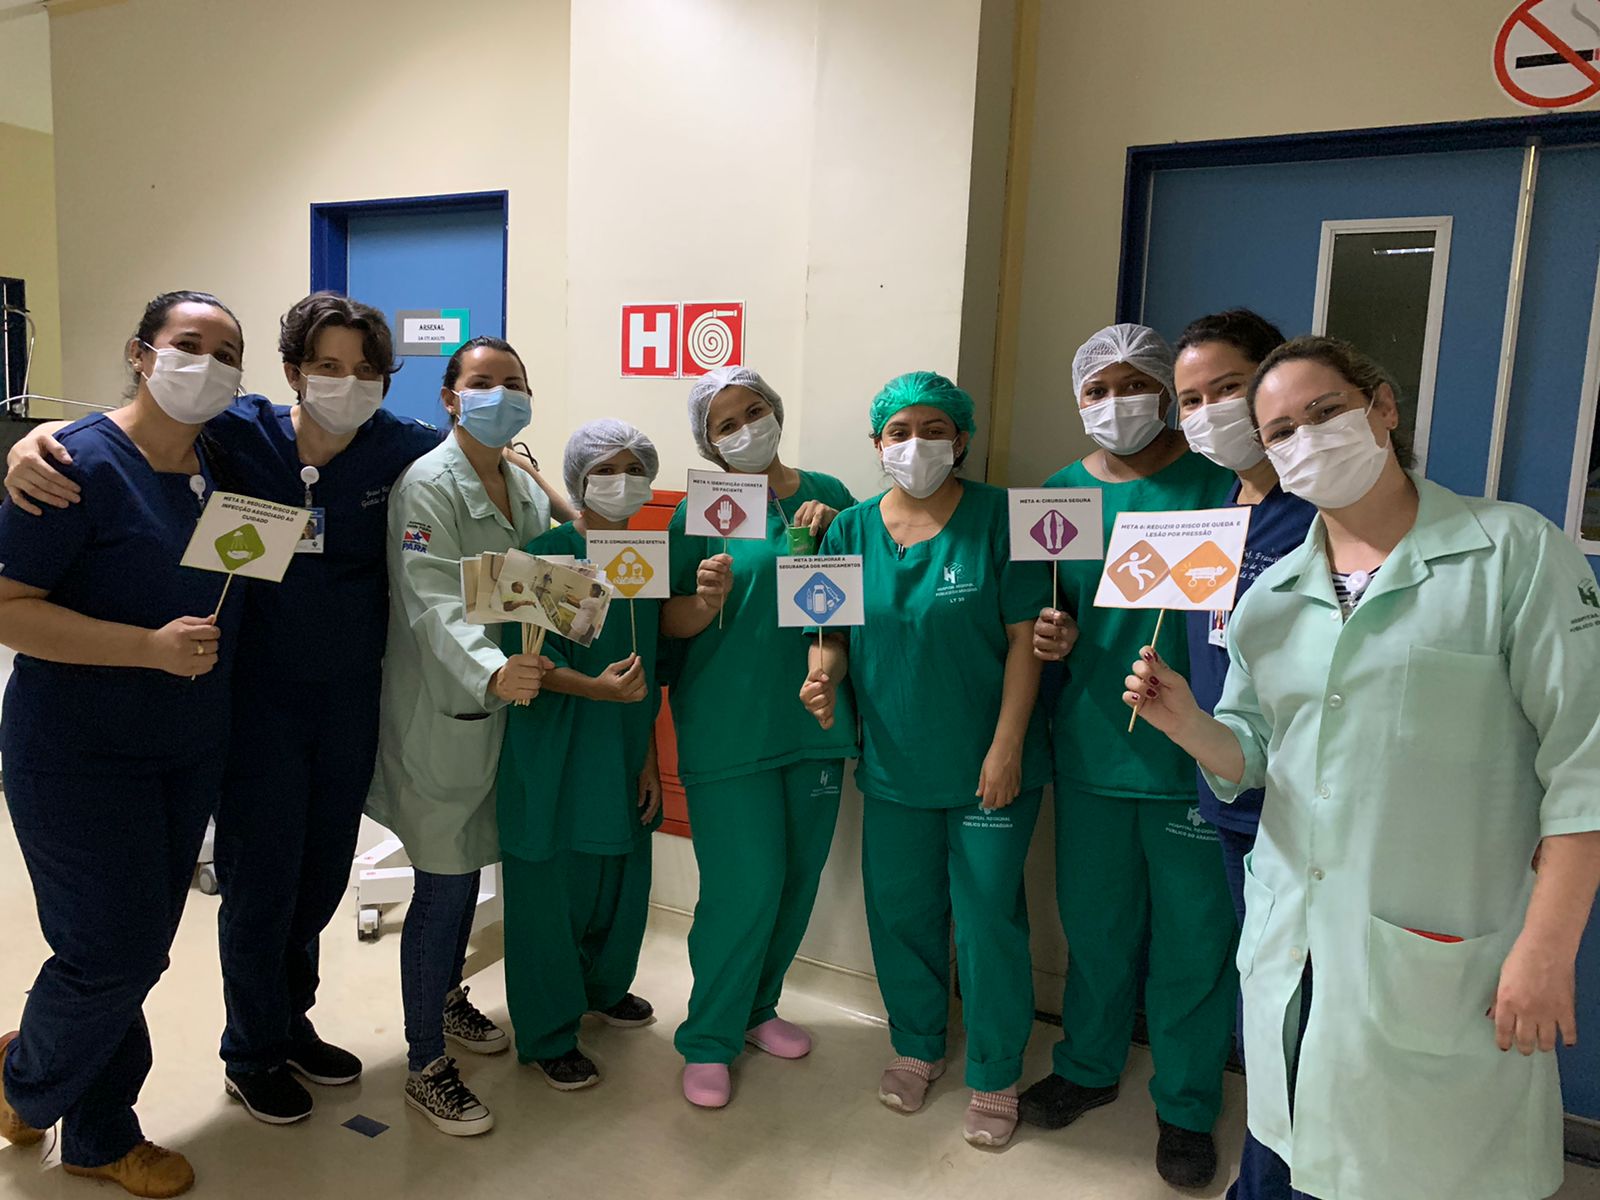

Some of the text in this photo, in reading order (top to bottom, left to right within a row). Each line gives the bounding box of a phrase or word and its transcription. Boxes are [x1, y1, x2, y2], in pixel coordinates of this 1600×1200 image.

[629, 312, 671, 368] H
[221, 503, 251, 513] INFECÇÃO
[252, 510, 285, 520] ASSOCIADO
[247, 500, 272, 510] REDUZIR
[272, 506, 290, 514] RISCO
[242, 514, 269, 524] CUIDADO
